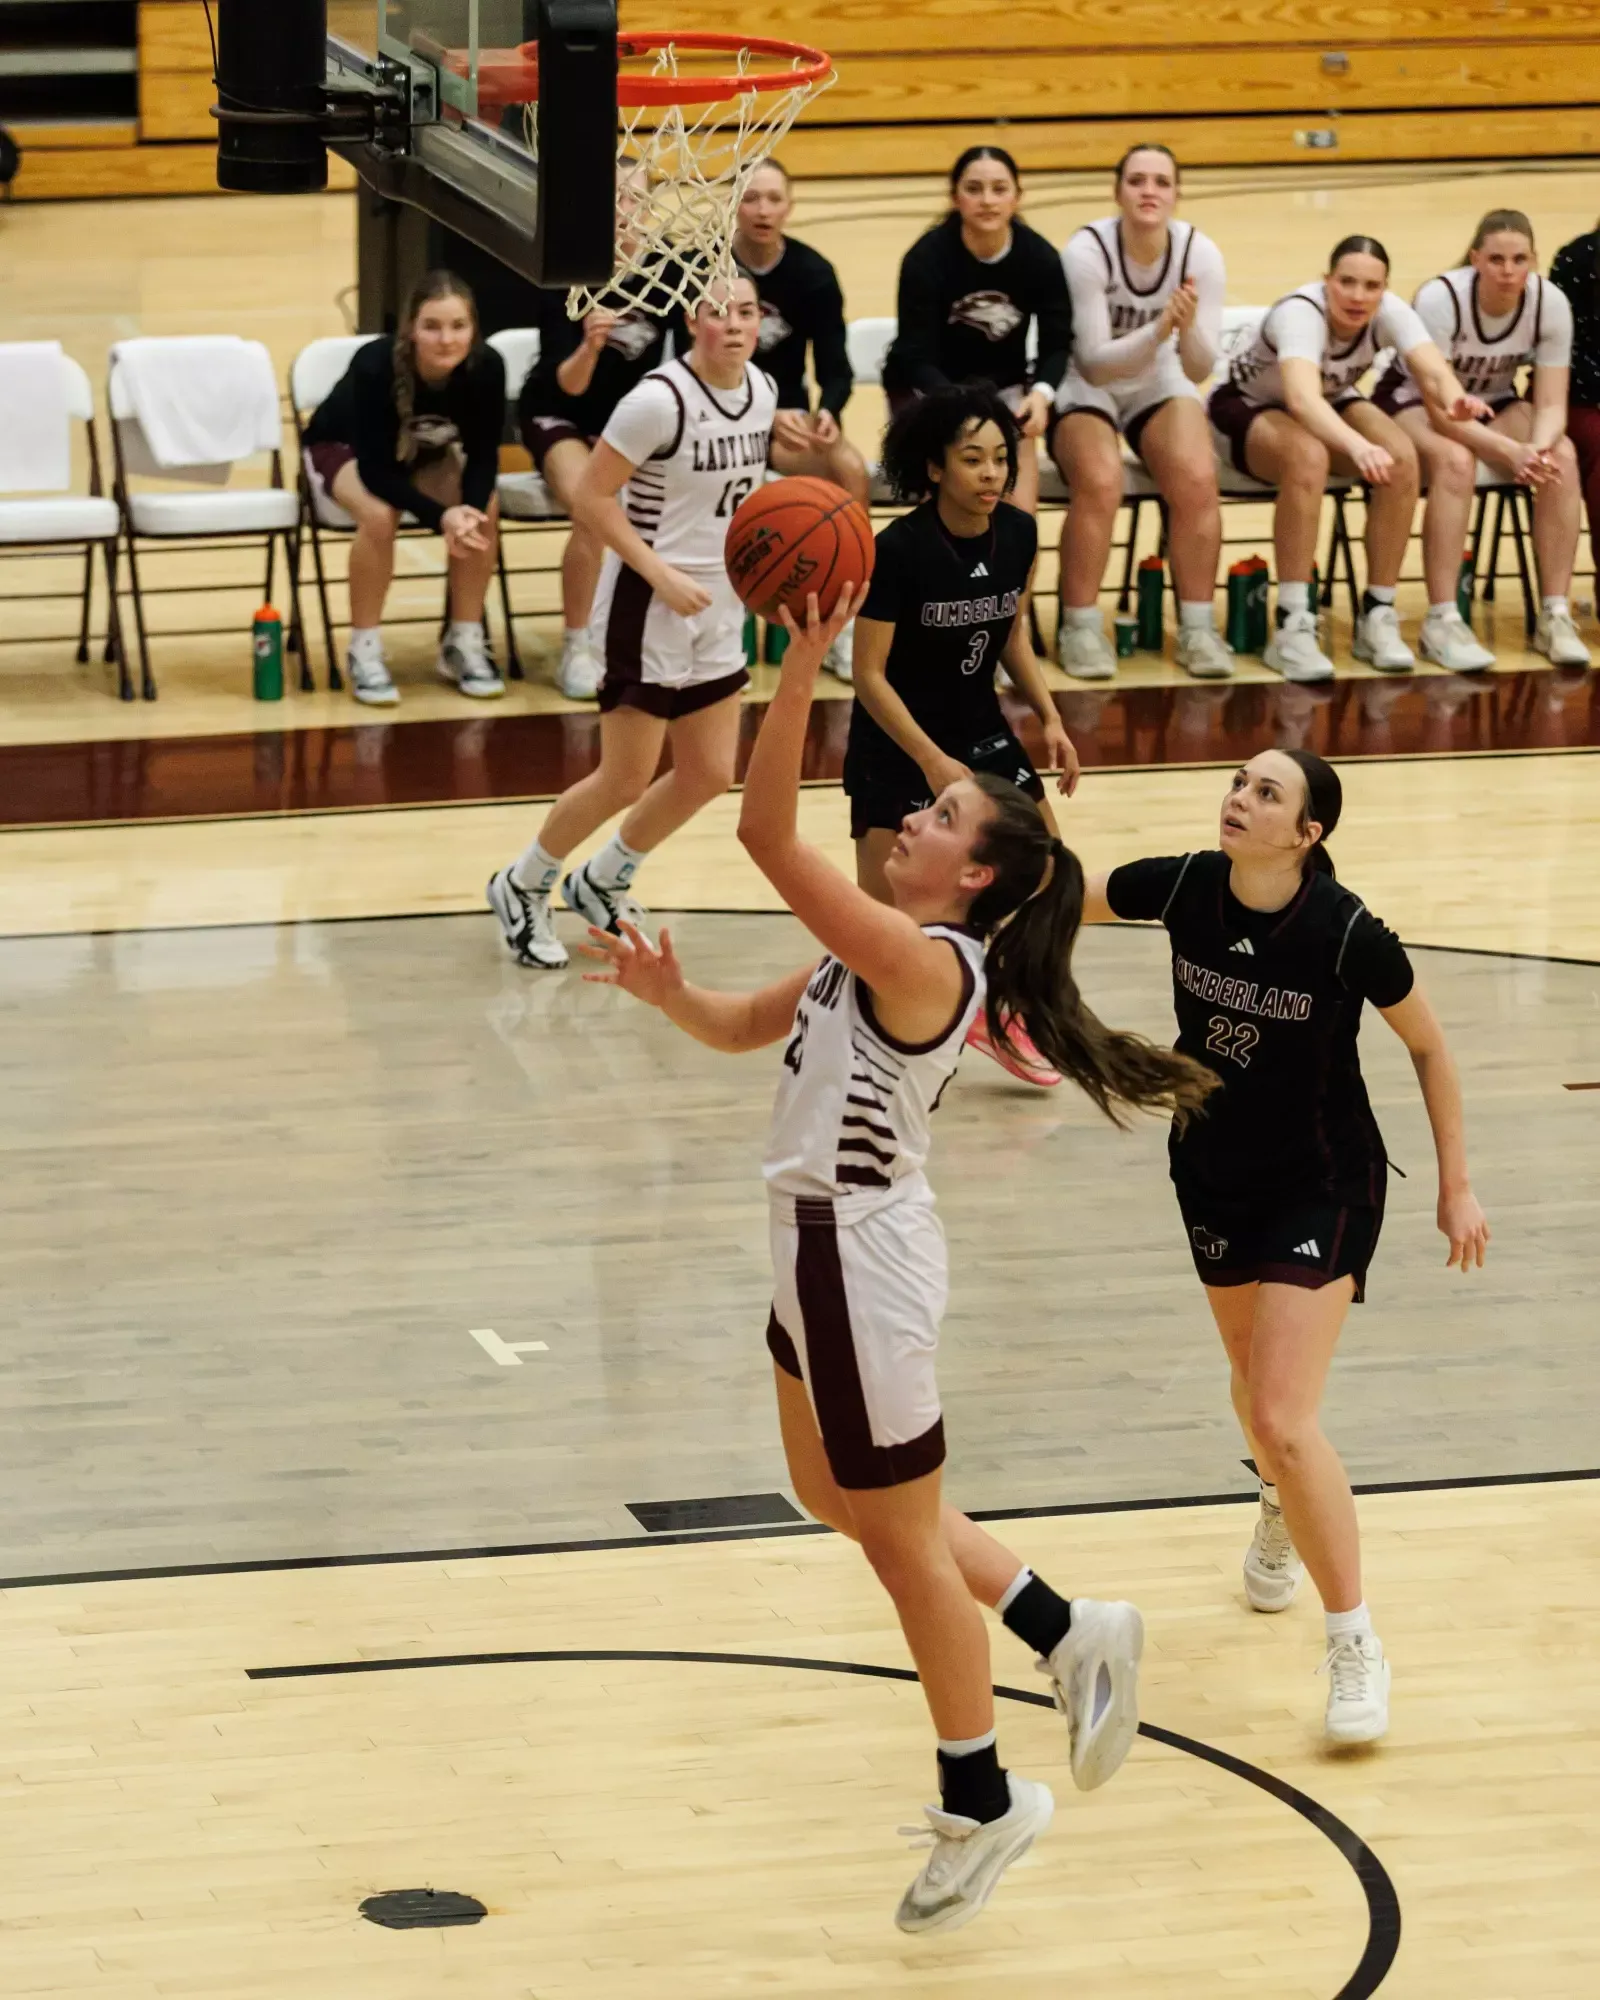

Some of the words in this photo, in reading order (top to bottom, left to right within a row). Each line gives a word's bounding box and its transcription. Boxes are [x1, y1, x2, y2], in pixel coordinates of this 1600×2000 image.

[693, 435, 736, 471] LADY
[921, 588, 1020, 627] CUMBERLAN
[960, 630, 990, 675] 3
[1206, 1015, 1260, 1069] 22
